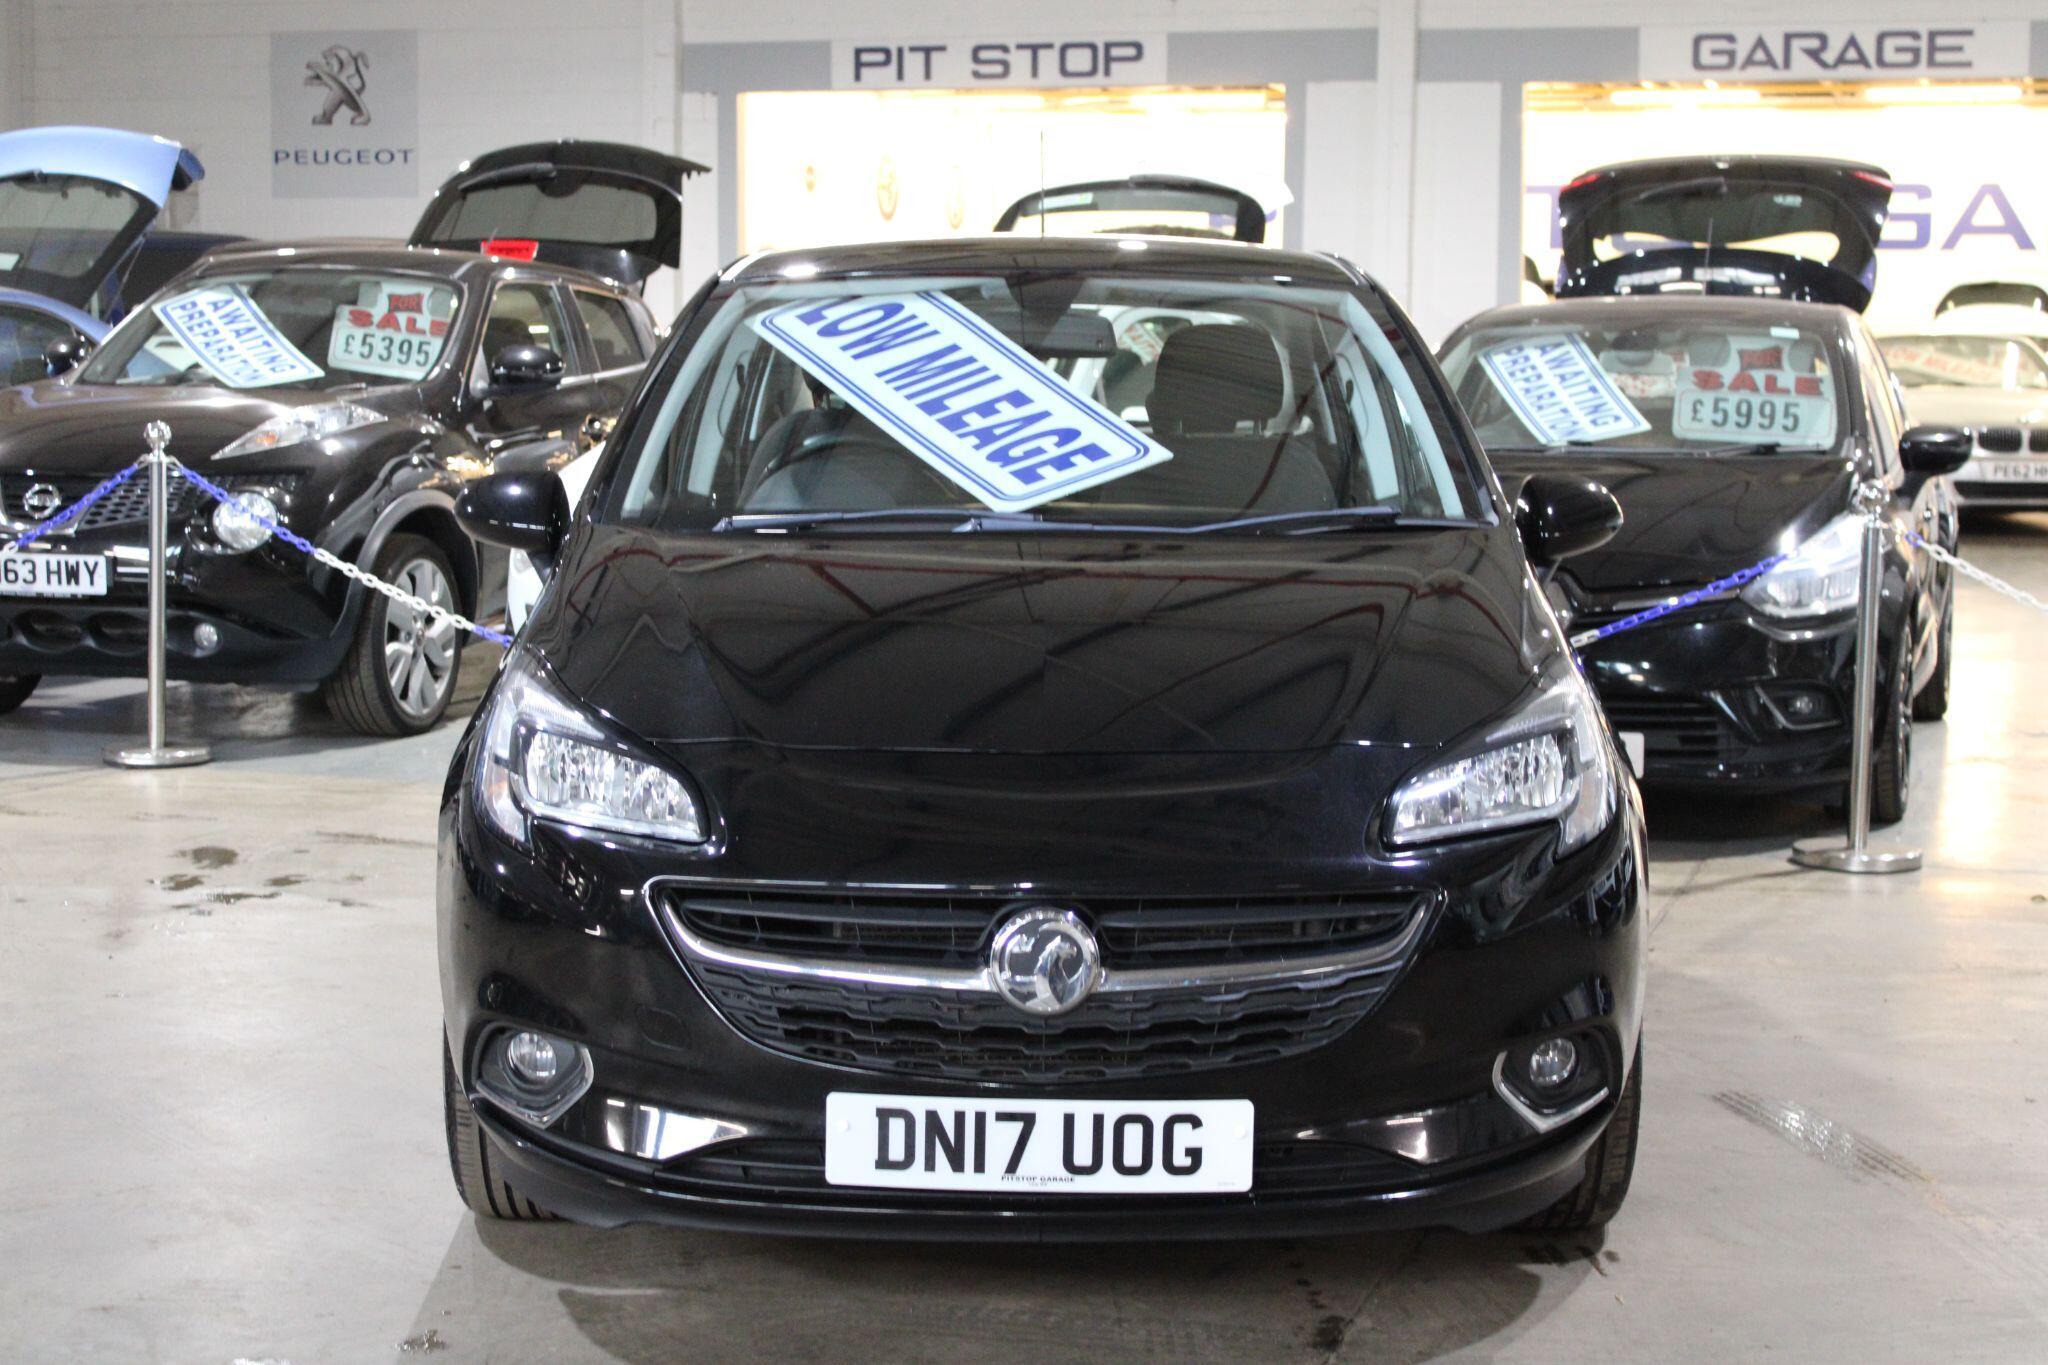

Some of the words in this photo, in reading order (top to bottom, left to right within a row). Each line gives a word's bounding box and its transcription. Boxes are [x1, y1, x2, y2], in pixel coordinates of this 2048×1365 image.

[855, 46, 947, 82] PIT
[970, 41, 1143, 80] STOP
[1692, 29, 1973, 71] GARAGE
[273, 149, 415, 165] PEUGEOT
[206, 298, 297, 373] AWAITING
[348, 309, 449, 336] SALE
[343, 334, 432, 368] £5395
[795, 297, 941, 361] LOW
[874, 343, 1112, 486] MILEAGE
[1534, 342, 1622, 427] AWAITING
[1692, 370, 1824, 396] SALE
[1691, 397, 1800, 432] £5995
[0, 559, 36, 584] 63
[46, 560, 98, 587] HWY
[1062, 1113, 1203, 1176] UOG
